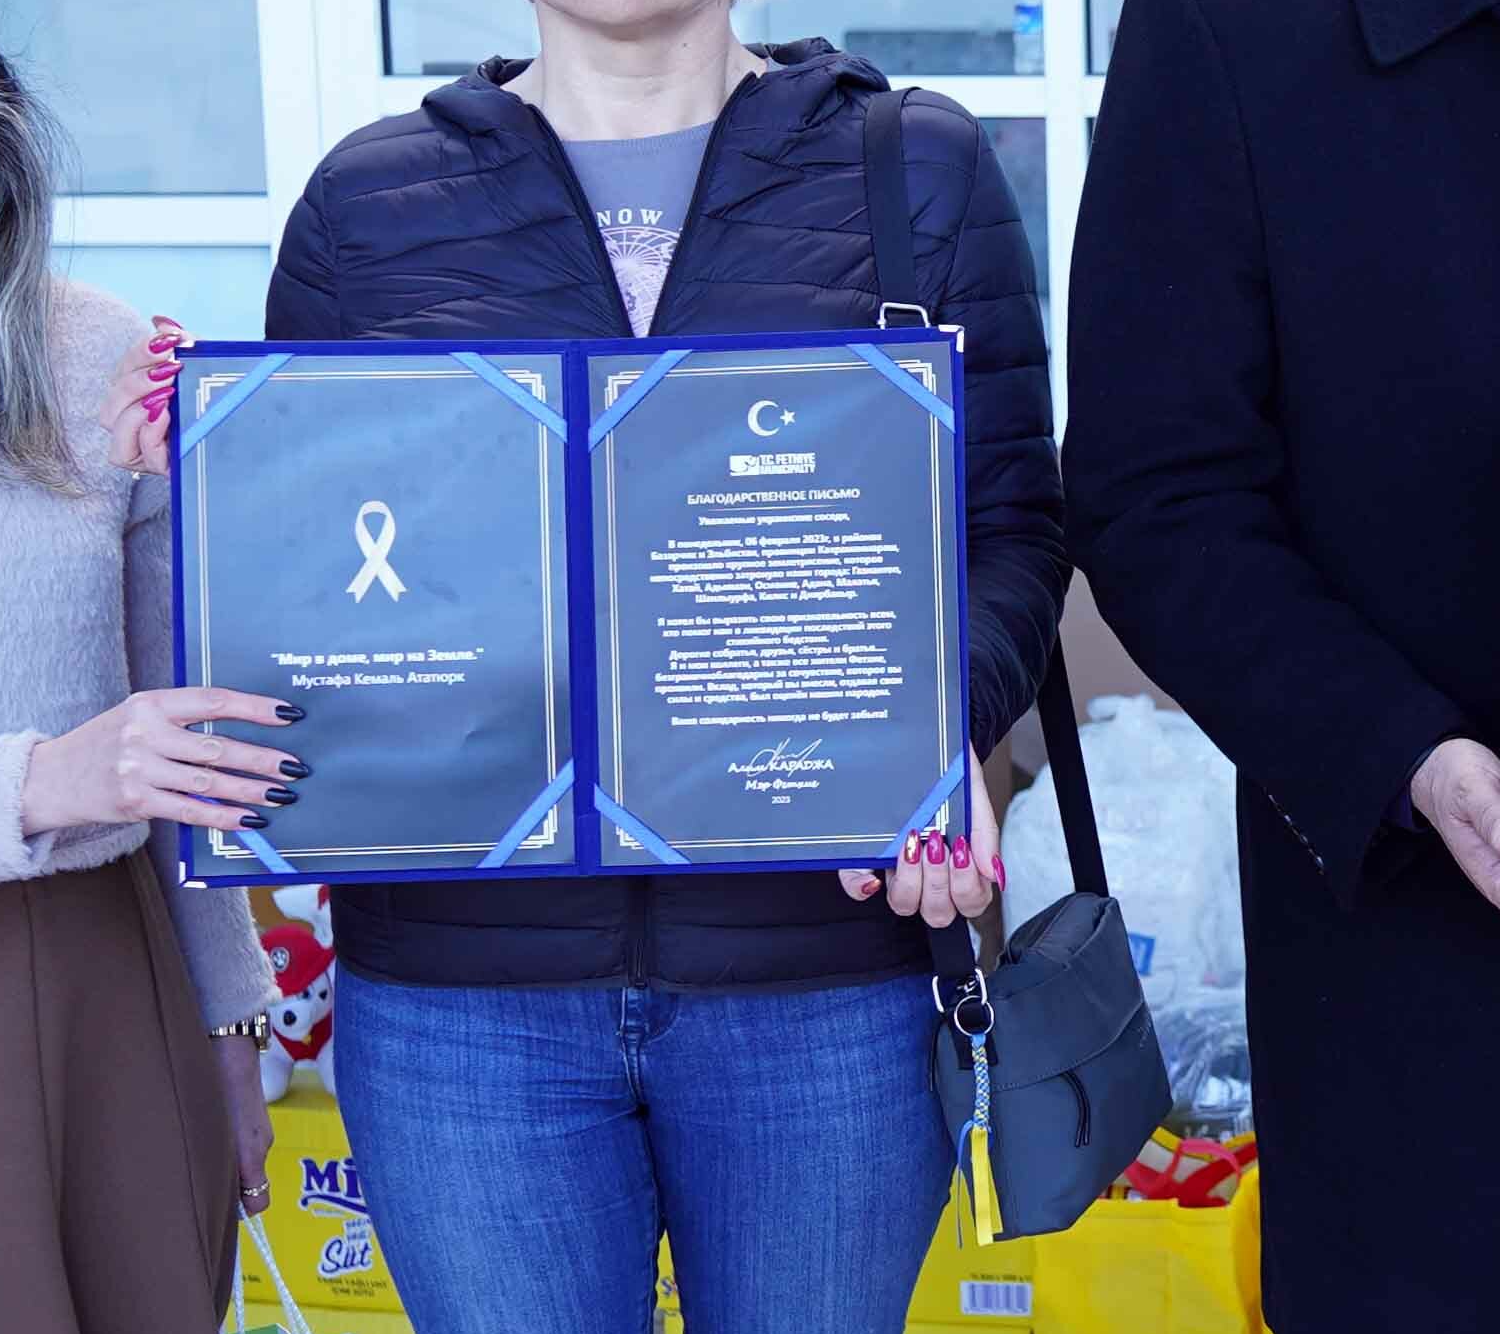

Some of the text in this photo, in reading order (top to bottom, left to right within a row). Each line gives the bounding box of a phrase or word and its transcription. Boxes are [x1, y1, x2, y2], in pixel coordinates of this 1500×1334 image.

[687, 488, 860, 505] БЛАГОДАРСТВЕННОЕ ПИСЬМО
[292, 671, 466, 689] Мустафа Кемаль Ататюрк
